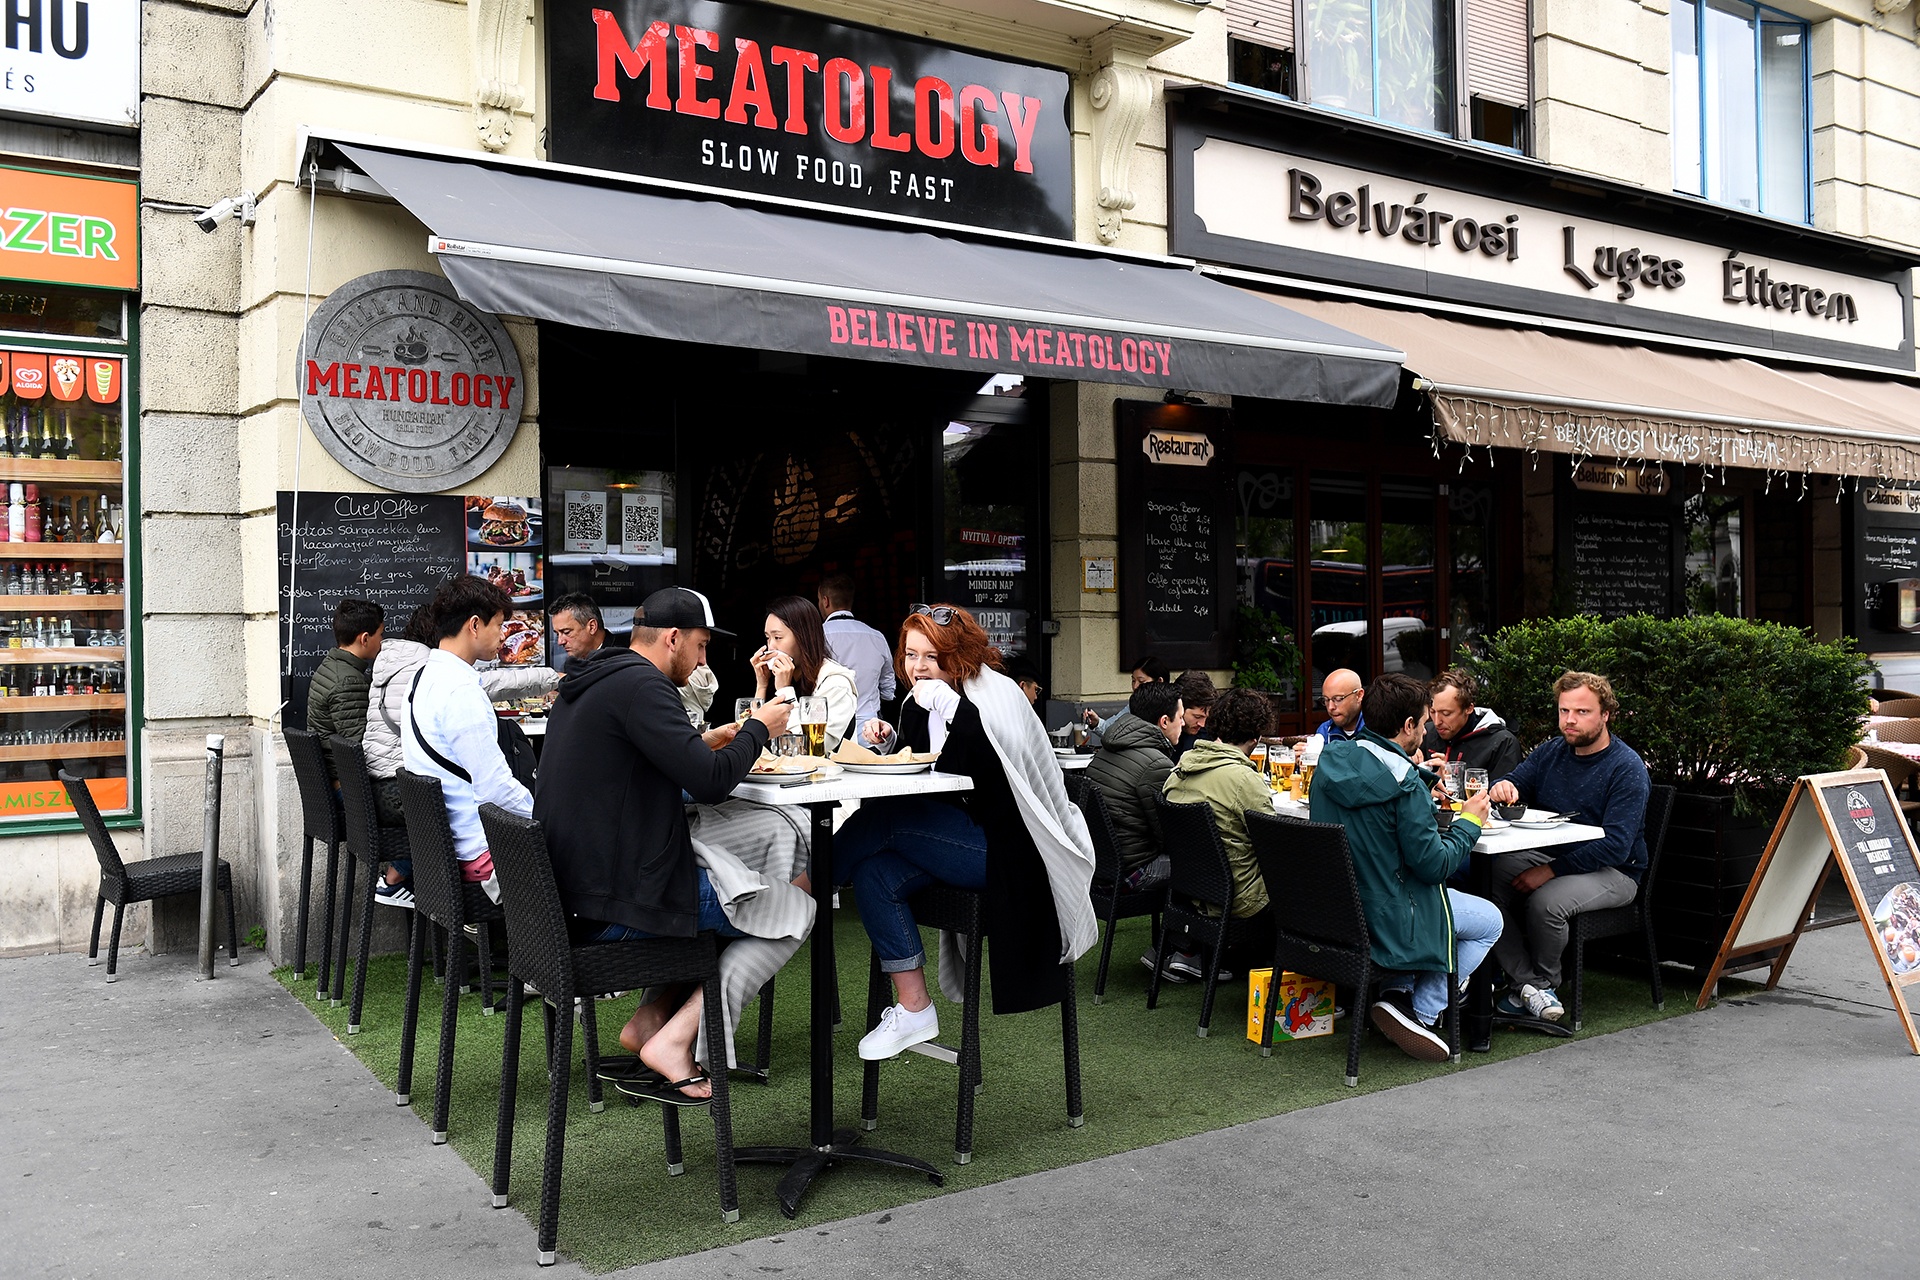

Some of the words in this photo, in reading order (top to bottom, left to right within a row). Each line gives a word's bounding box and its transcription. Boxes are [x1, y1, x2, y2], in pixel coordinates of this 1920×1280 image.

[591, 8, 1042, 175] MEATOLOGY
[701, 139, 778, 176] SLOW
[796, 156, 875, 196] FOOD,
[890, 170, 955, 203] FAST
[0, 207, 119, 261] ZER
[1288, 167, 1519, 261] Belvárosi
[1563, 225, 1686, 301] Lugas
[1722, 251, 1858, 323] Étterem
[330, 298, 385, 348] GRILL
[398, 293, 442, 315] AND
[451, 311, 496, 364] BEER
[826, 305, 958, 357] BELIEVE
[967, 321, 1000, 361] IN
[1010, 329, 1172, 377] MEATOLOGY
[307, 360, 515, 409] MEATOLOGY
[382, 410, 447, 424] HUNGARIAN
[336, 414, 381, 457] SLOW
[450, 422, 488, 462] FAST
[1150, 434, 1208, 461] Restaurant
[334, 495, 379, 521] Chef
[381, 498, 429, 520] Offer
[962, 531, 990, 543] NYITVA
[998, 535, 1017, 546] OPEN
[282, 551, 353, 571] Ederflower
[350, 553, 391, 571] yellow
[968, 580, 997, 590] MINDEN
[999, 580, 1014, 590] NAP
[978, 612, 1011, 628] OPEN
[1001, 633, 1014, 642] DAY
